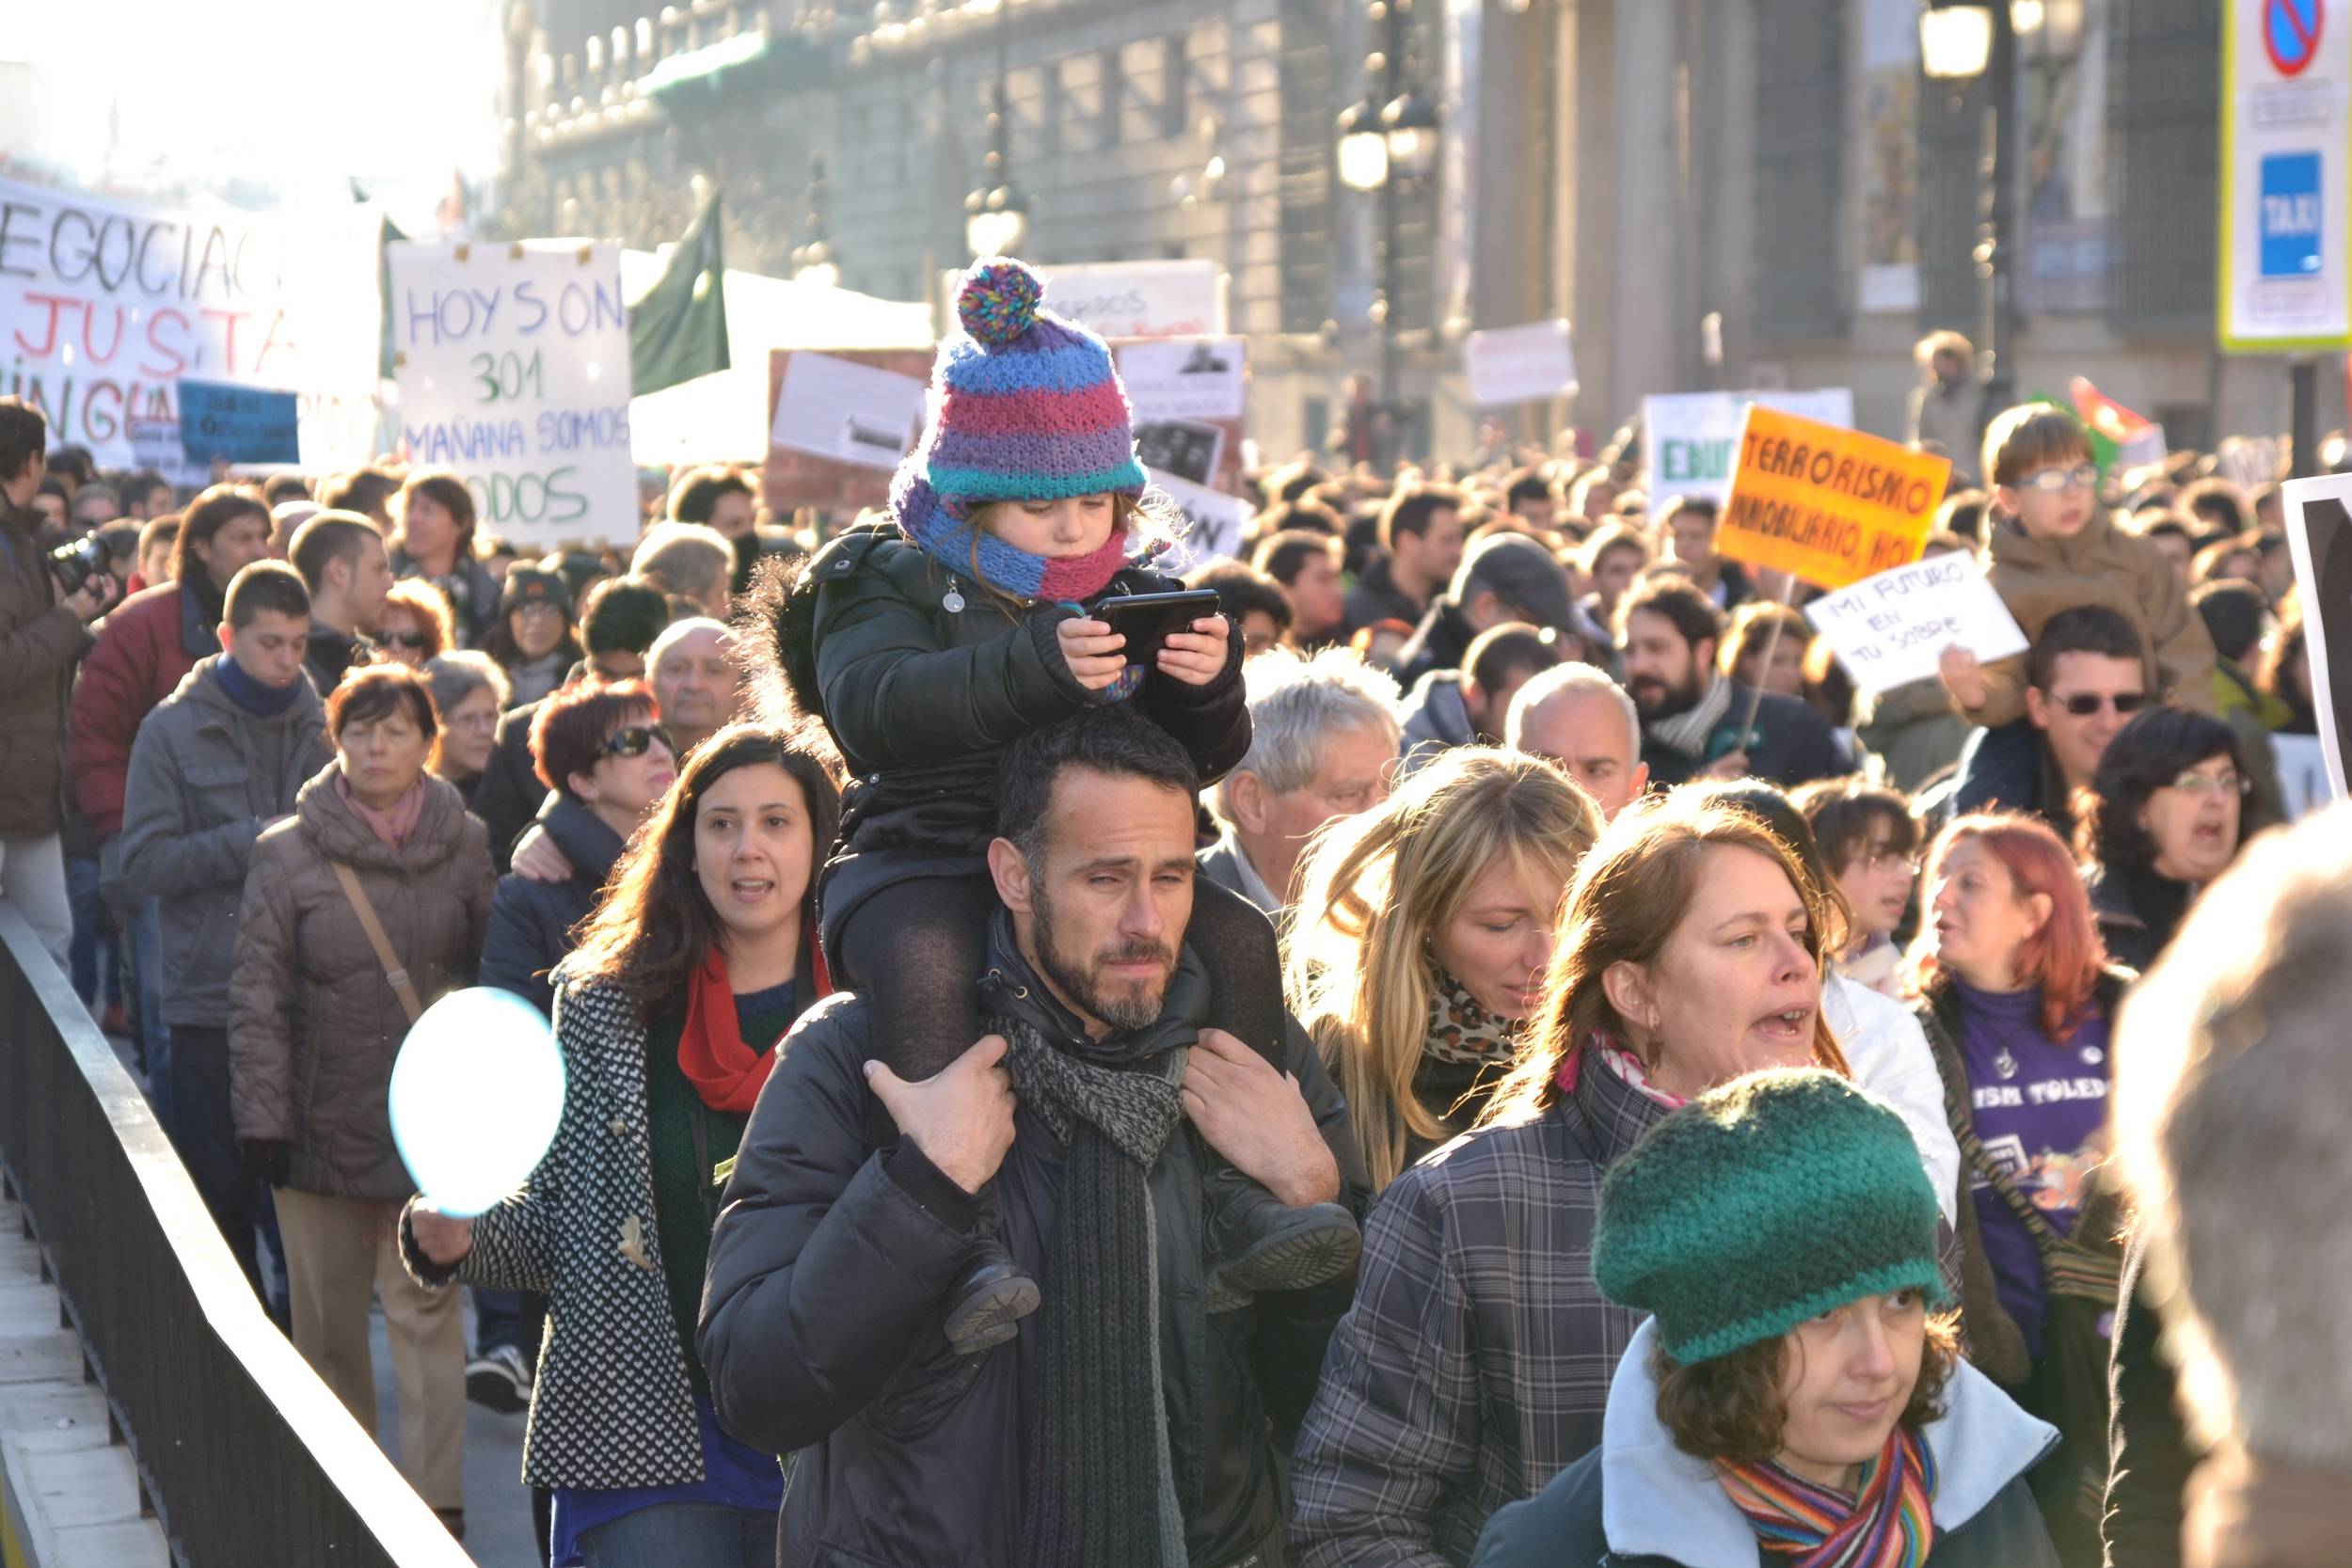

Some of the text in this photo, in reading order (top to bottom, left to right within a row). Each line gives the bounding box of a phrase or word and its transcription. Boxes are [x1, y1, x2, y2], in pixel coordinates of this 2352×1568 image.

[2264, 194, 2319, 235] TAXI
[13, 293, 296, 379] JUSTA
[405, 273, 628, 345] HOY SON
[471, 347, 544, 403] 301
[405, 416, 527, 463] MAÑANA
[537, 406, 629, 453] SOMOS
[1747, 433, 1931, 515] TERRORISMO
[1829, 562, 1964, 618] MI FUTURO
[1850, 616, 1963, 662] TU SOBRE
[1867, 608, 1903, 632] EN
